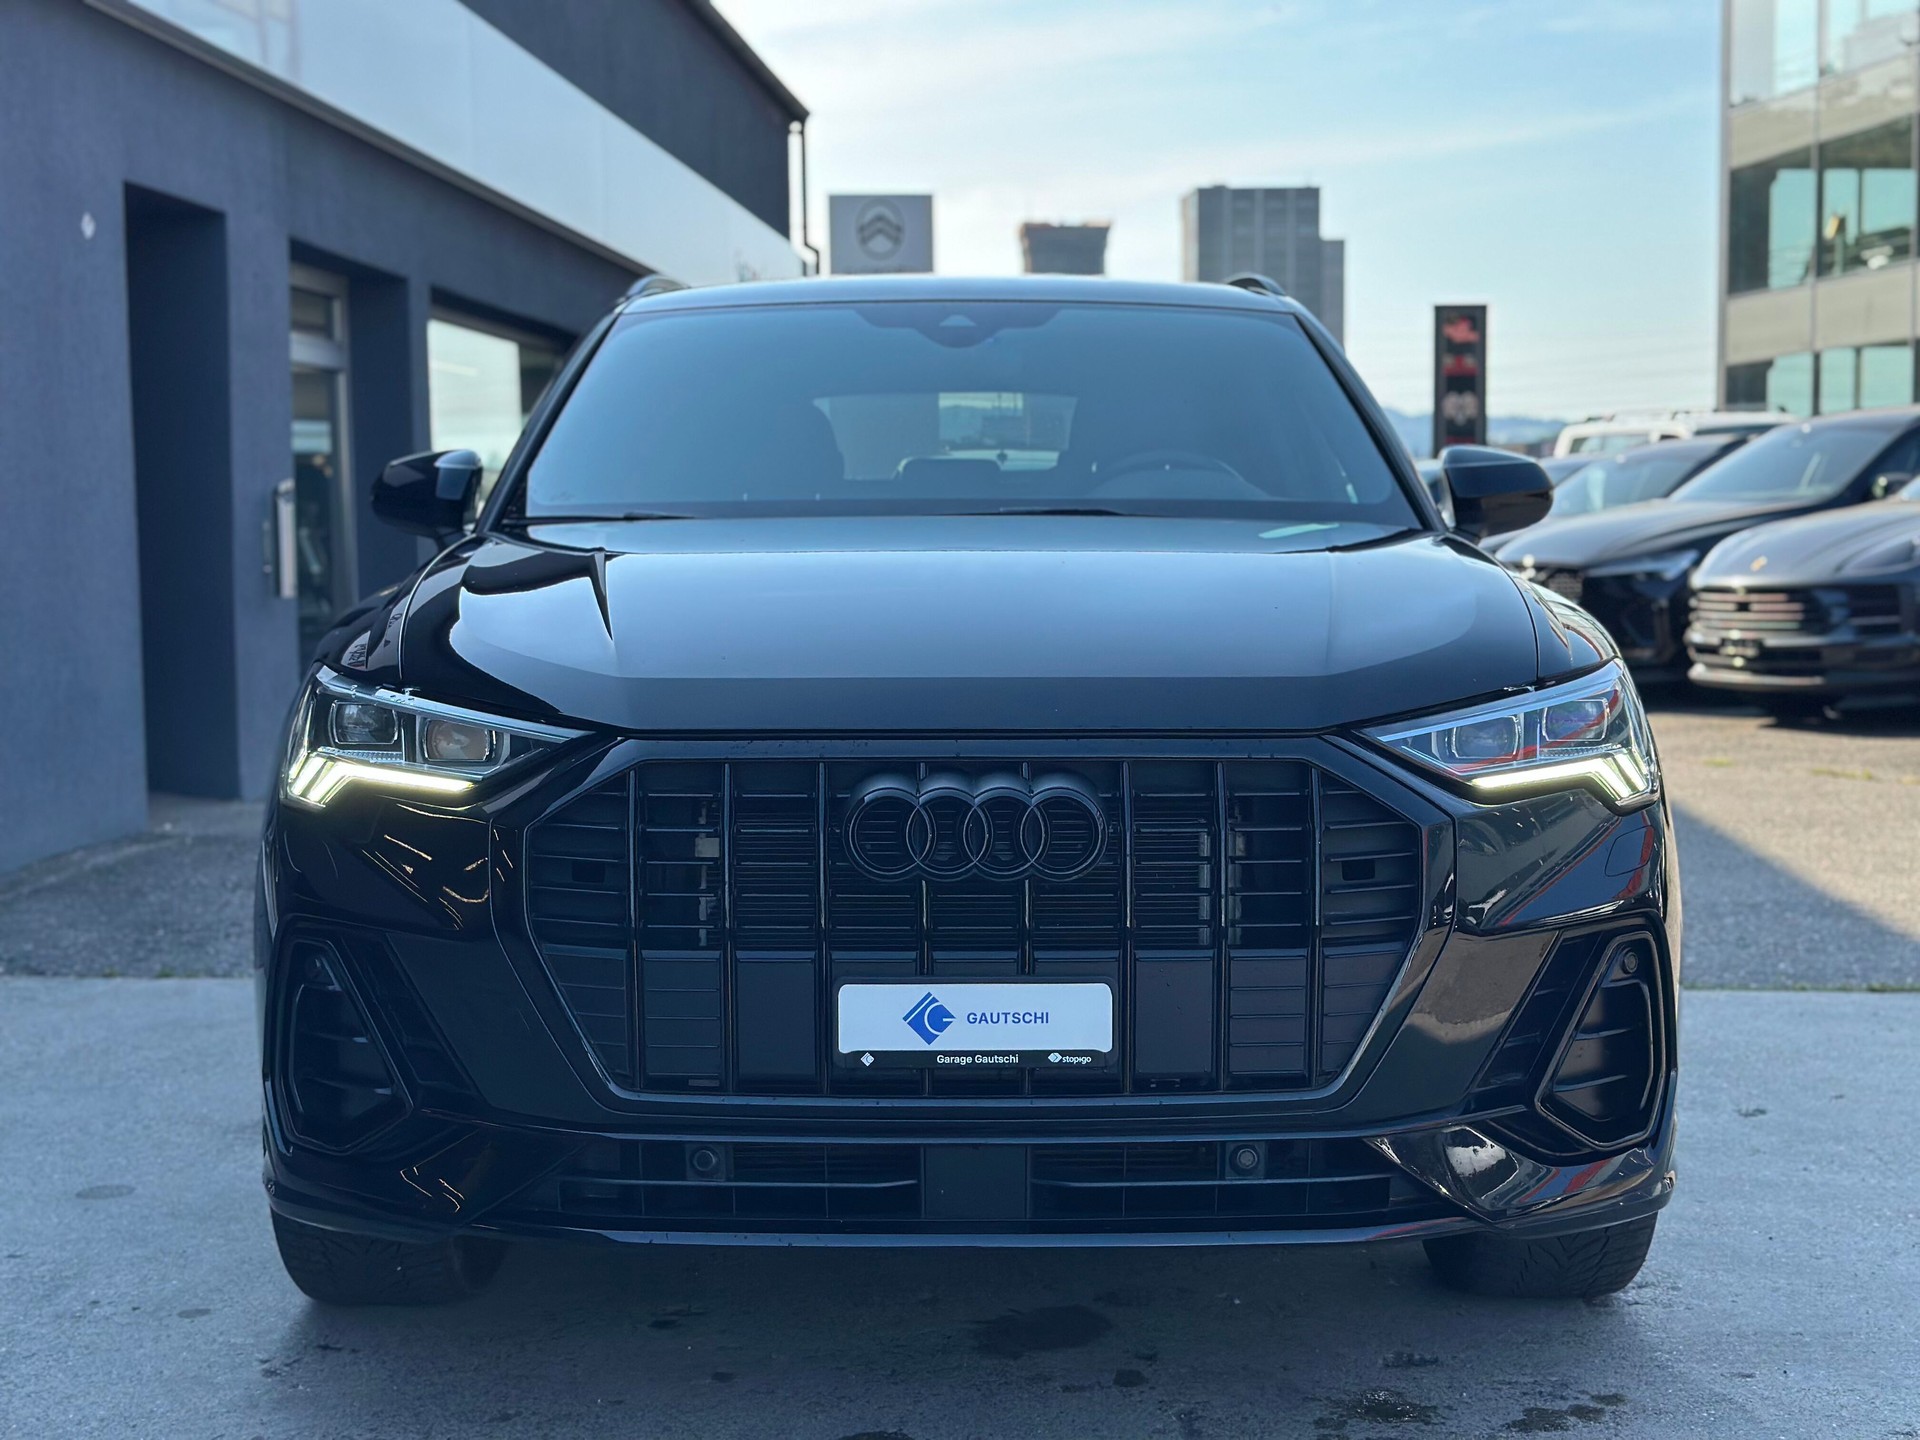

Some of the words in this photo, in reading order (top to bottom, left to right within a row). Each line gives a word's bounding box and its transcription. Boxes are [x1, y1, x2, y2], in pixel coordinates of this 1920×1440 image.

[966, 1012, 1049, 1024] GAUTSCHI
[936, 1054, 973, 1066] Garage
[974, 1053, 1019, 1064] Gautschi
